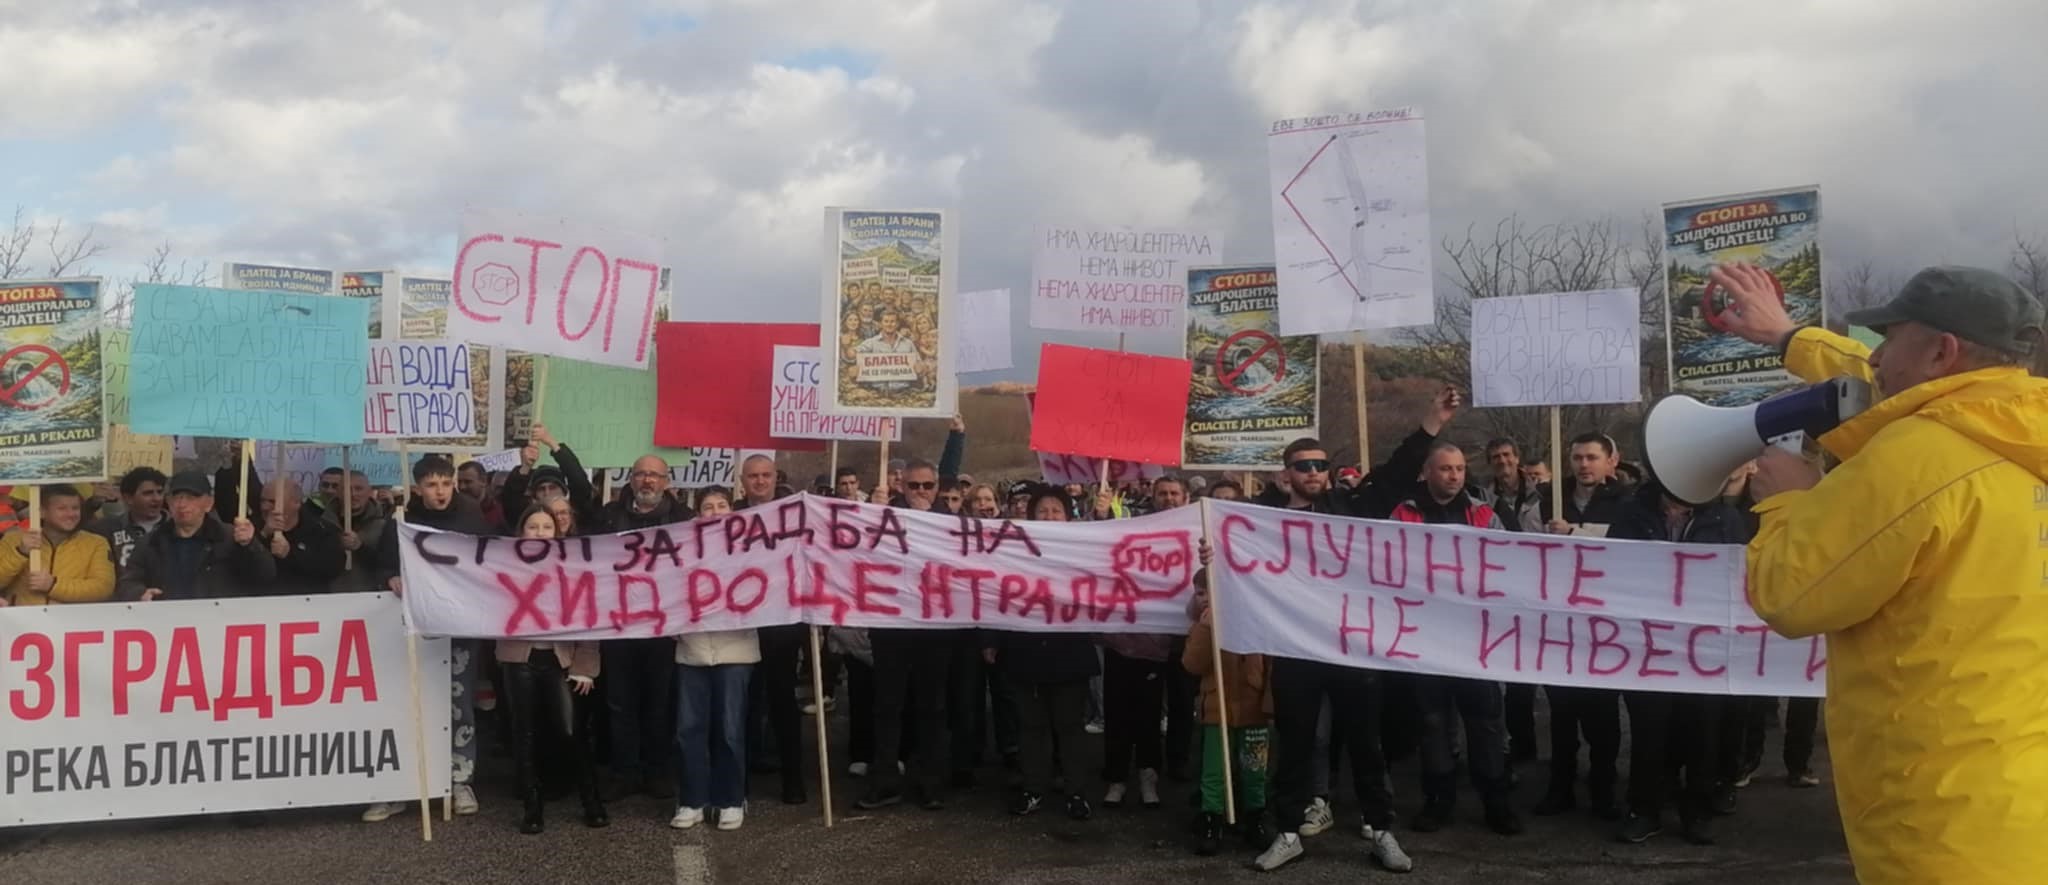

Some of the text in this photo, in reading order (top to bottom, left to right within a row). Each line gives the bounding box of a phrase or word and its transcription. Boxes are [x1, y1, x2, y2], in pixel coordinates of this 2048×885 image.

[1696, 203, 1769, 225] СТОП ЗА
[1673, 212, 1808, 245] ХИДРОЦЕНТРАЛА ВО
[1703, 227, 1775, 251] БЛАТЕЦ!
[1080, 256, 1118, 277] НЕМА
[478, 273, 515, 297] STOP
[1037, 279, 1081, 299] НЕМА
[1215, 272, 1257, 289] СТОП
[0, 287, 57, 302] ТОП ЗА
[75, 299, 91, 309] ВО
[453, 233, 658, 362] СТОП
[1193, 286, 1278, 305] ХИДРОЦЕНТРА
[1476, 298, 1529, 336] ОВА
[1538, 293, 1576, 334] НЕ
[864, 355, 910, 368] БЛАТЕЦ
[1476, 327, 1638, 374] БИЗНИС ОВА
[400, 344, 470, 390] ВОДА
[783, 361, 820, 385] СТО
[1679, 356, 1783, 378] СПАСЕТЕ ЈА РЕК
[772, 384, 820, 410] УНИ
[364, 392, 397, 434] ШЕ
[398, 392, 470, 434] ПРАВО
[774, 411, 797, 433] НА
[1190, 415, 1308, 433] СПАСЕТЕ ЈА РЕКАТА!
[0, 434, 20, 447] ЕТЕ
[22, 432, 38, 446] ЈА
[41, 427, 95, 442] РЕКАТА!
[950, 514, 1042, 557] НА
[1221, 514, 1606, 606] СЛУШНЕТЕ
[496, 555, 1138, 635] ХИДРОЦЕНТРАЛА
[1339, 593, 1424, 658] НЕ
[8, 618, 379, 722] ЗГРАДБА
[6, 728, 400, 795] РЕКА БЛАТЕШНИЦА
